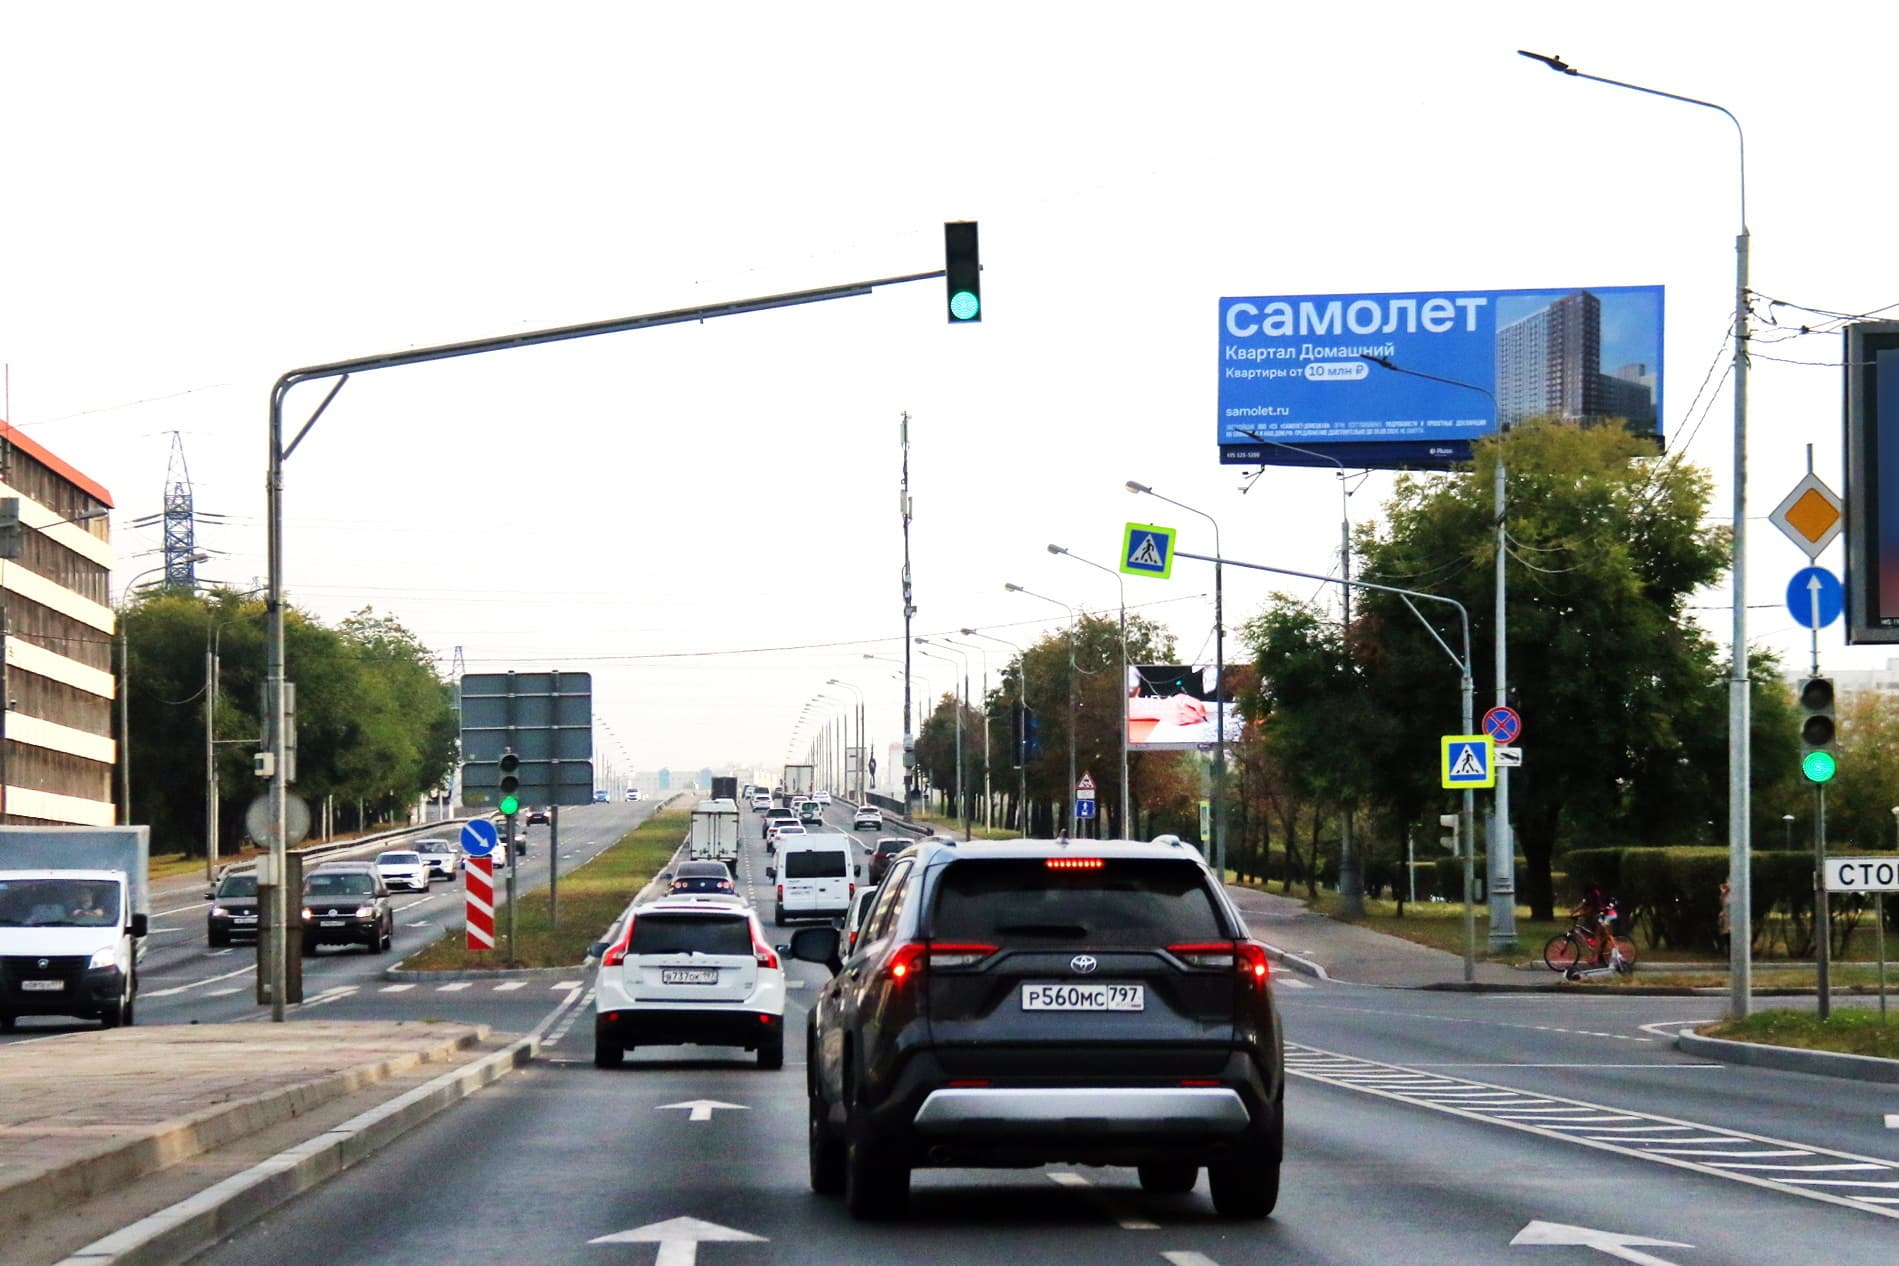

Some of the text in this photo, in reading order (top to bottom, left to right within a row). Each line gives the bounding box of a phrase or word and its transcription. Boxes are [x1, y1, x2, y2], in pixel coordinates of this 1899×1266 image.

[1226, 297, 1487, 336] самолет
[1225, 343, 1395, 362] Квартал Домашний
[1225, 367, 1287, 380] Квартиры
[1290, 368, 1304, 378] от
[1308, 366, 1324, 377] 10
[1327, 367, 1353, 376] млн
[1225, 405, 1289, 416] samolet.ru
[1839, 863, 1899, 885] СТО
[1029, 987, 1138, 1006] Р560МС 797
